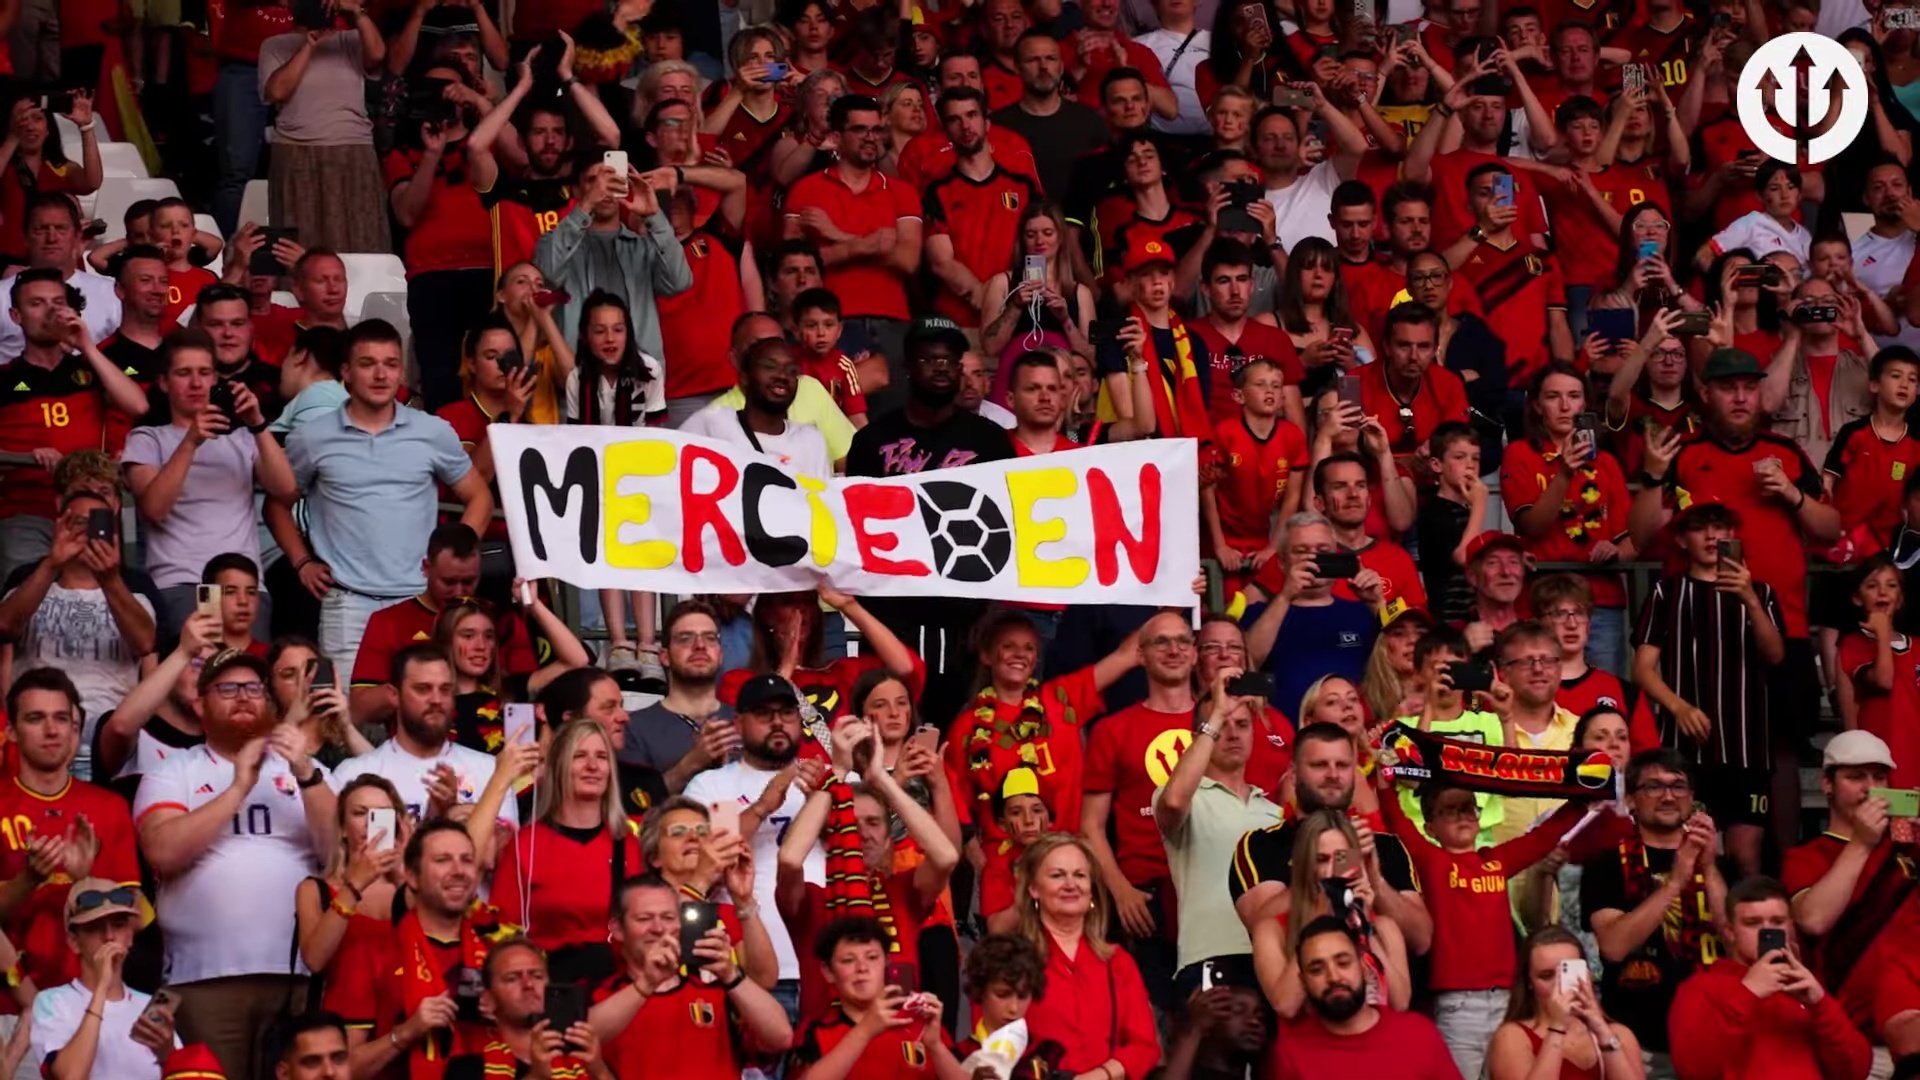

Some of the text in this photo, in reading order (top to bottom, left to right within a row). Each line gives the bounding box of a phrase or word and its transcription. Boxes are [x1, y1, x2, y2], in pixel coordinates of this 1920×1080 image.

[1661, 59, 1687, 86] 10
[535, 210, 559, 234] 18
[41, 402, 70, 428] 18
[1440, 744, 1568, 783] BELGIEN
[1749, 793, 1768, 814] 10
[3, 815, 32, 851] 10
[233, 804, 271, 835] 10
[770, 816, 792, 847] 7
